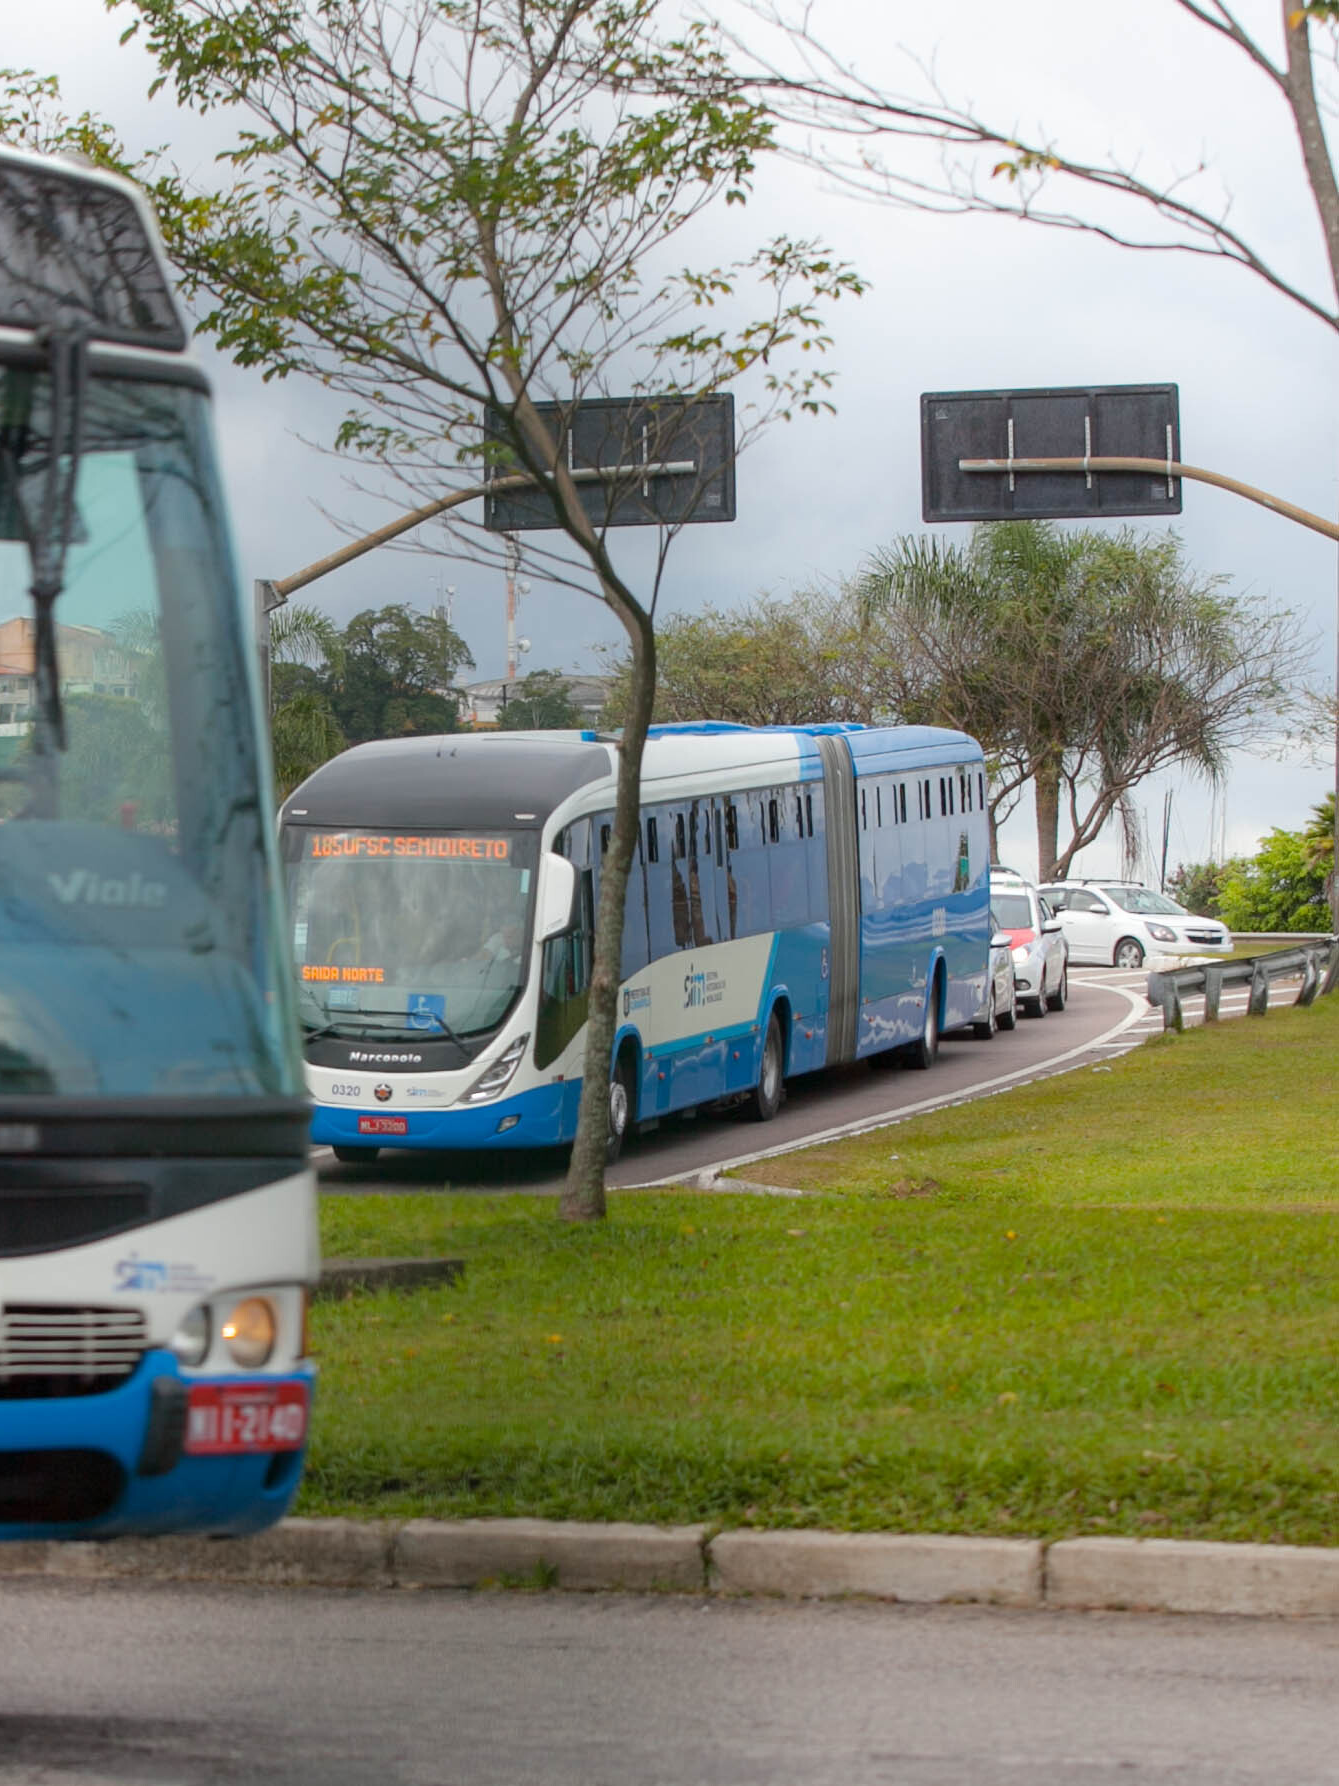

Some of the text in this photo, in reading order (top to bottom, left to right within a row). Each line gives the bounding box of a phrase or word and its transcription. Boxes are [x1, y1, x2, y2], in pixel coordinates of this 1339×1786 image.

[393, 836, 508, 859] SEMIDIRETO
[47, 868, 168, 908] Viale
[302, 965, 385, 983] SAIDA NORTE
[349, 1051, 422, 1064] Marcopolo
[331, 1084, 361, 1097] 0320
